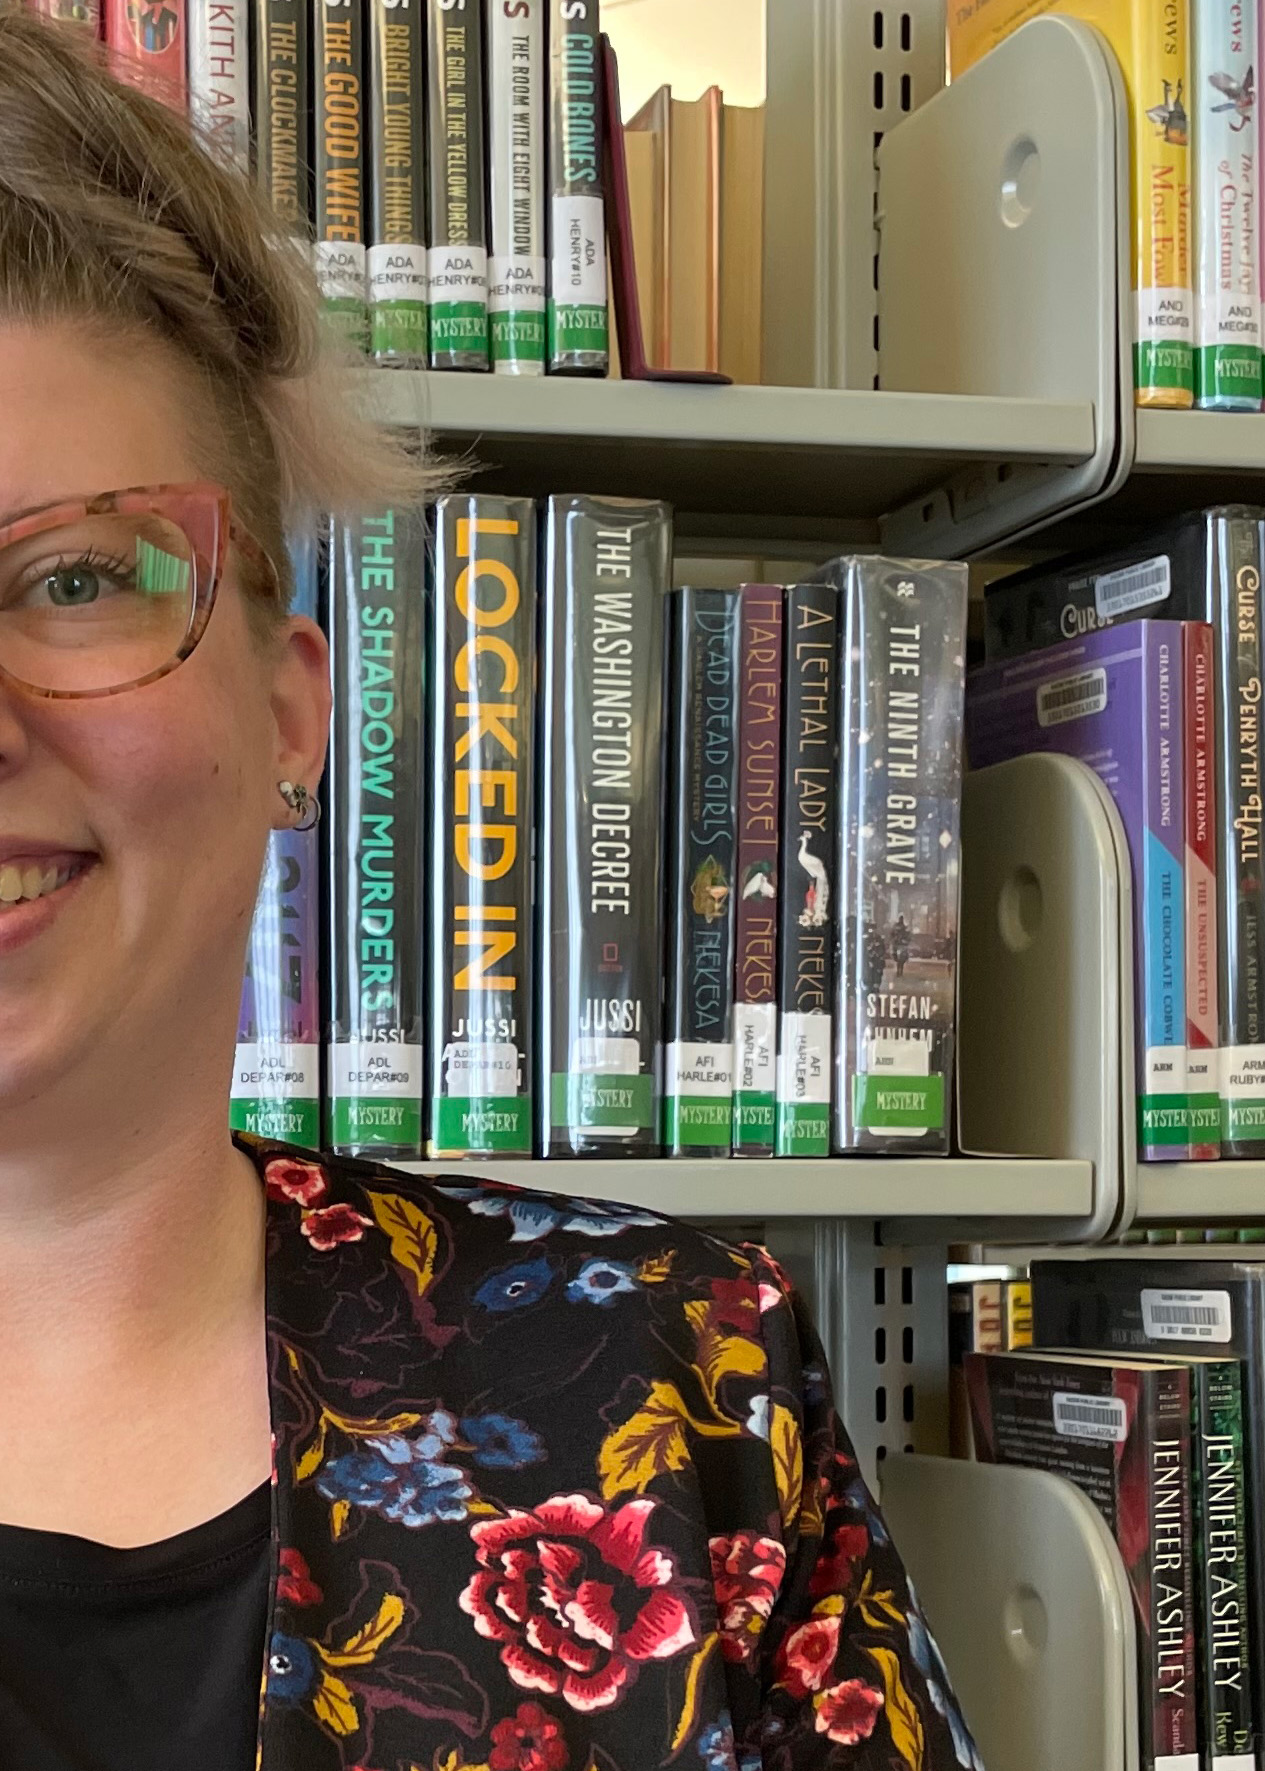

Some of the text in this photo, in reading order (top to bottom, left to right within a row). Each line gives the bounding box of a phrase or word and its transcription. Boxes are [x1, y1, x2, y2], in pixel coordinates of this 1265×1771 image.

[209, 4, 236, 79] KITH
[270, 20, 297, 62] THE
[512, 34, 530, 60] THE
[512, 63, 530, 106] ROOM
[323, 18, 361, 242] THE GOOD WIFE
[384, 25, 413, 243] BRIGHT YOUNG THINGS
[445, 26, 468, 201] THE GIRL IN THE YELLOW
[512, 109, 530, 147] WITH
[562, 98, 596, 183] BONES
[512, 151, 531, 193] EIGHT
[1151, 164, 1175, 226] Most
[386, 256, 414, 269] ADA
[444, 258, 474, 270] ADA
[584, 238, 596, 267] ADA
[1219, 184, 1239, 291] Christmas
[505, 267, 533, 280] ADA
[596, 528, 632, 578] THE
[1236, 565, 1259, 643] CURSE
[454, 517, 521, 881] LOCKED
[592, 592, 633, 789] WASHINGTON
[793, 604, 834, 832] A LETHAL LADY
[705, 696, 730, 766] DEAD
[743, 600, 783, 853] HARLEM SUNSET
[885, 624, 921, 885] THE NINTH GRAVE
[1158, 643, 1171, 828] CHARLOTTE ARMSTRONG
[1194, 653, 1207, 843] CHARLOTTE ARMSTRONG
[1238, 676, 1261, 788] PENRYTH
[360, 510, 395, 1012] THE SHADOW MURDERS
[1234, 794, 1262, 863] HALL
[590, 803, 632, 915] DECREE
[453, 905, 517, 991] IN
[451, 1018, 517, 1037] JUSSI
[579, 998, 641, 1032] JUSSI
[866, 993, 931, 1020] STEFAN
[260, 1058, 285, 1068] ADL
[367, 1058, 392, 1068] ADL
[696, 1056, 714, 1067] AFI
[758, 1046, 769, 1067] AFI
[810, 1055, 821, 1077] AFI
[245, 1113, 305, 1133] MYSTERY
[347, 1106, 405, 1126] MYSTERY
[462, 1113, 519, 1132] MYSTERY
[679, 1106, 731, 1125] MYSTERY
[877, 1091, 927, 1110] MYSTERY
[1153, 1439, 1186, 1698] JENNIFER ASHLEY
[1202, 1434, 1242, 1692] JENNIFER ASHLEY
